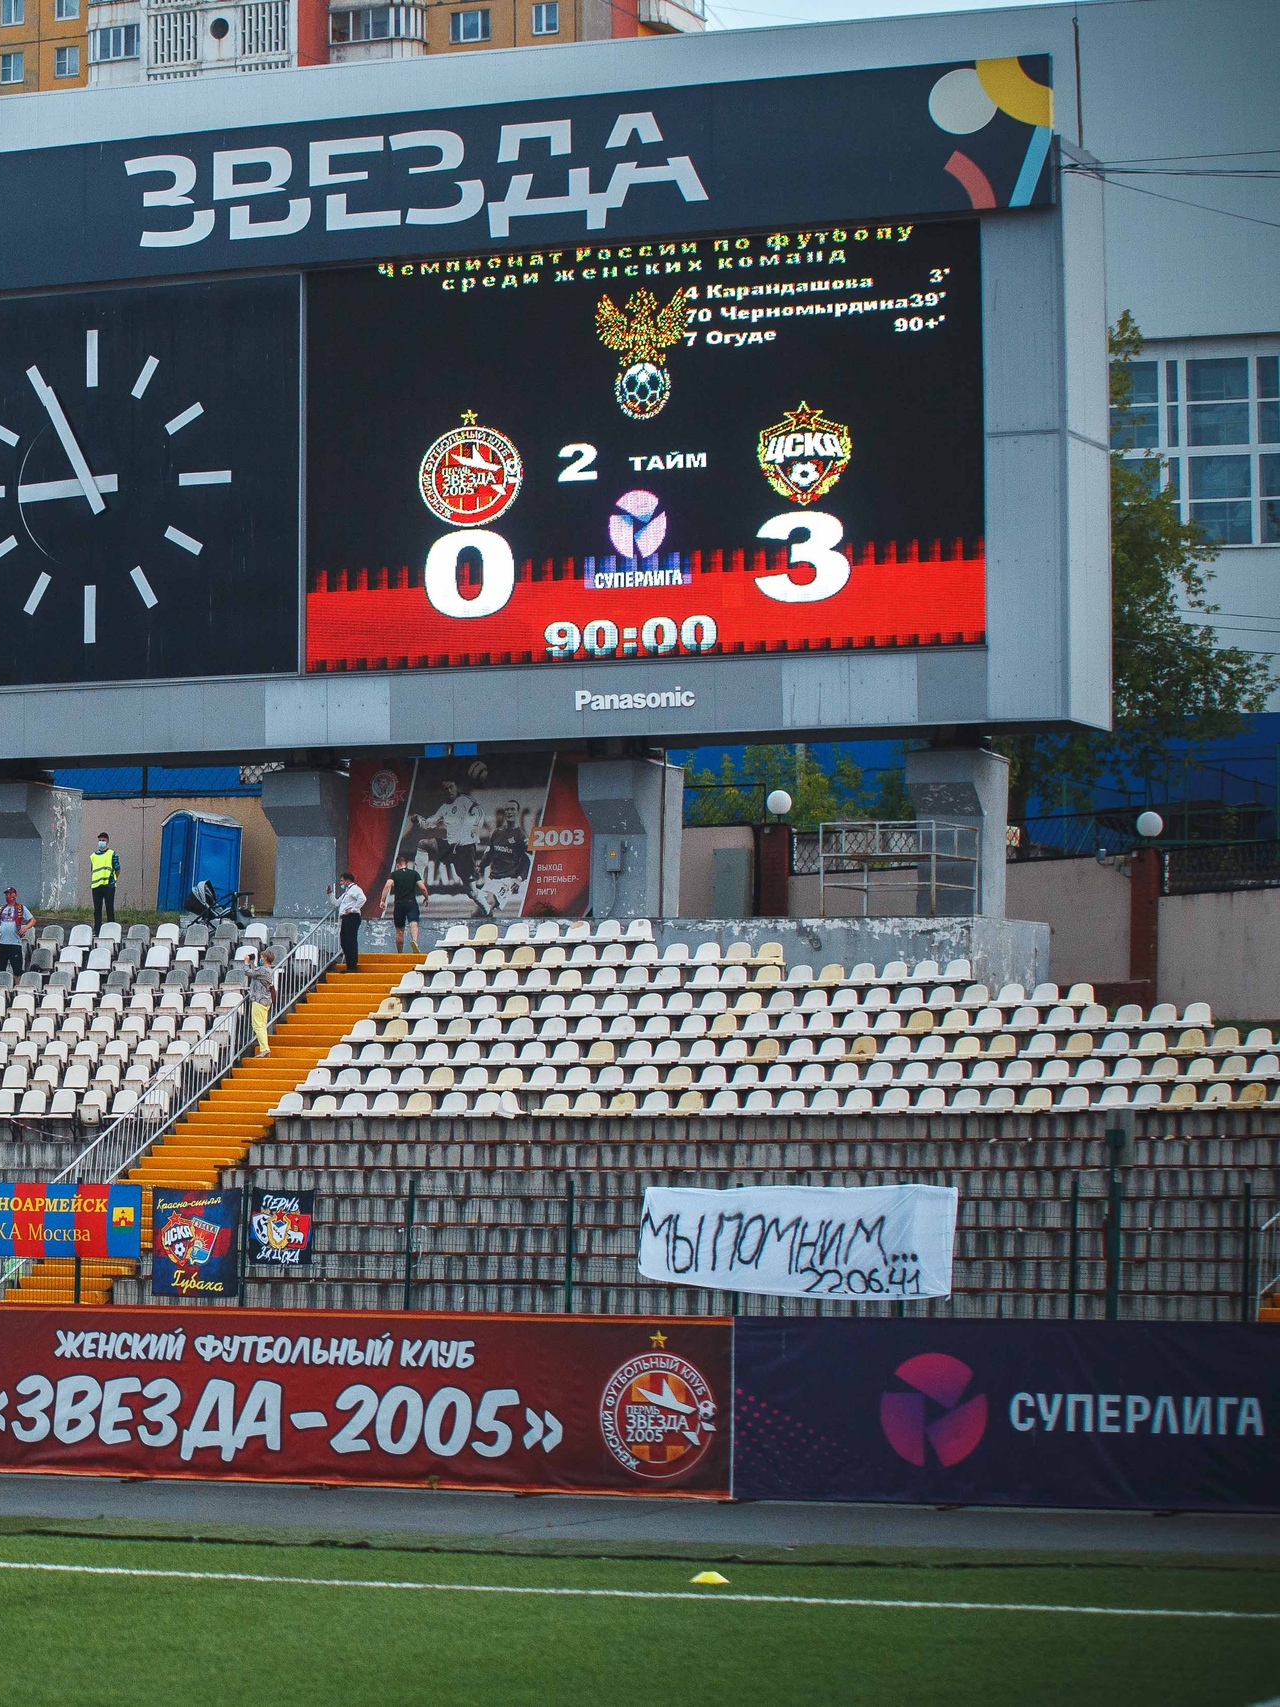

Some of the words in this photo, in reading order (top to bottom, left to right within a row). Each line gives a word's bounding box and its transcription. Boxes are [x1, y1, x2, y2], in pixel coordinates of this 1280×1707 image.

[125, 110, 710, 248] ЗВЕЗДА
[377, 250, 564, 278] Чемпионат
[575, 238, 698, 263] России
[713, 237, 751, 252] по
[442, 271, 540, 293] среди
[554, 257, 703, 283] женских
[718, 248, 847, 271] команд
[684, 285, 699, 300] 4
[706, 276, 874, 301] Карандашова
[685, 307, 713, 324] 70
[720, 297, 908, 323] Черномырдина
[684, 330, 698, 348] 7
[705, 329, 777, 348] Огуде
[765, 431, 846, 464] ЦСКА
[558, 442, 598, 483] 2
[628, 450, 707, 472] ТАЙМ
[442, 472, 497, 487] ЗВЕЗДА
[442, 484, 475, 497] 2005
[754, 510, 851, 603] 3
[424, 528, 515, 619] 0
[594, 568, 684, 589] СУПЕРЛИГА
[543, 614, 718, 658] 90:00
[575, 685, 696, 712] Panasonic
[532, 829, 585, 847] 2003
[536, 876, 541, 884] В
[543, 874, 580, 884] ПРЕМЬЕР-
[537, 863, 563, 872] ВЫХОД
[536, 888, 557, 896] ЛИГУ!
[262, 1194, 300, 1212] ПЕРМЬ
[28, 1223, 92, 1242] Москва
[164, 1224, 194, 1247] ЦСКА
[639, 1207, 705, 1274] МЫ
[256, 1245, 272, 1261] ЗА
[272, 1248, 301, 1264] ЦСКА
[170, 1269, 225, 1294] Губаха
[54, 1326, 187, 1362] ЖЕНСКИЙ
[194, 1332, 395, 1368] ФУТБОЛЬНЫЙ
[400, 1338, 476, 1369] КЛУБ
[605, 1357, 681, 1407] ФУТБОЛЬНЫЙ
[680, 1364, 707, 1396] КЛУБ
[625, 1404, 661, 1416] ПЕРМЬ
[1008, 1391, 1265, 1437] СУПЕРЛИГА
[625, 1414, 690, 1434] ЗВЕЗДА
[626, 1429, 664, 1443] 2005
[601, 1409, 641, 1470] ЖЕНСКИЙ
